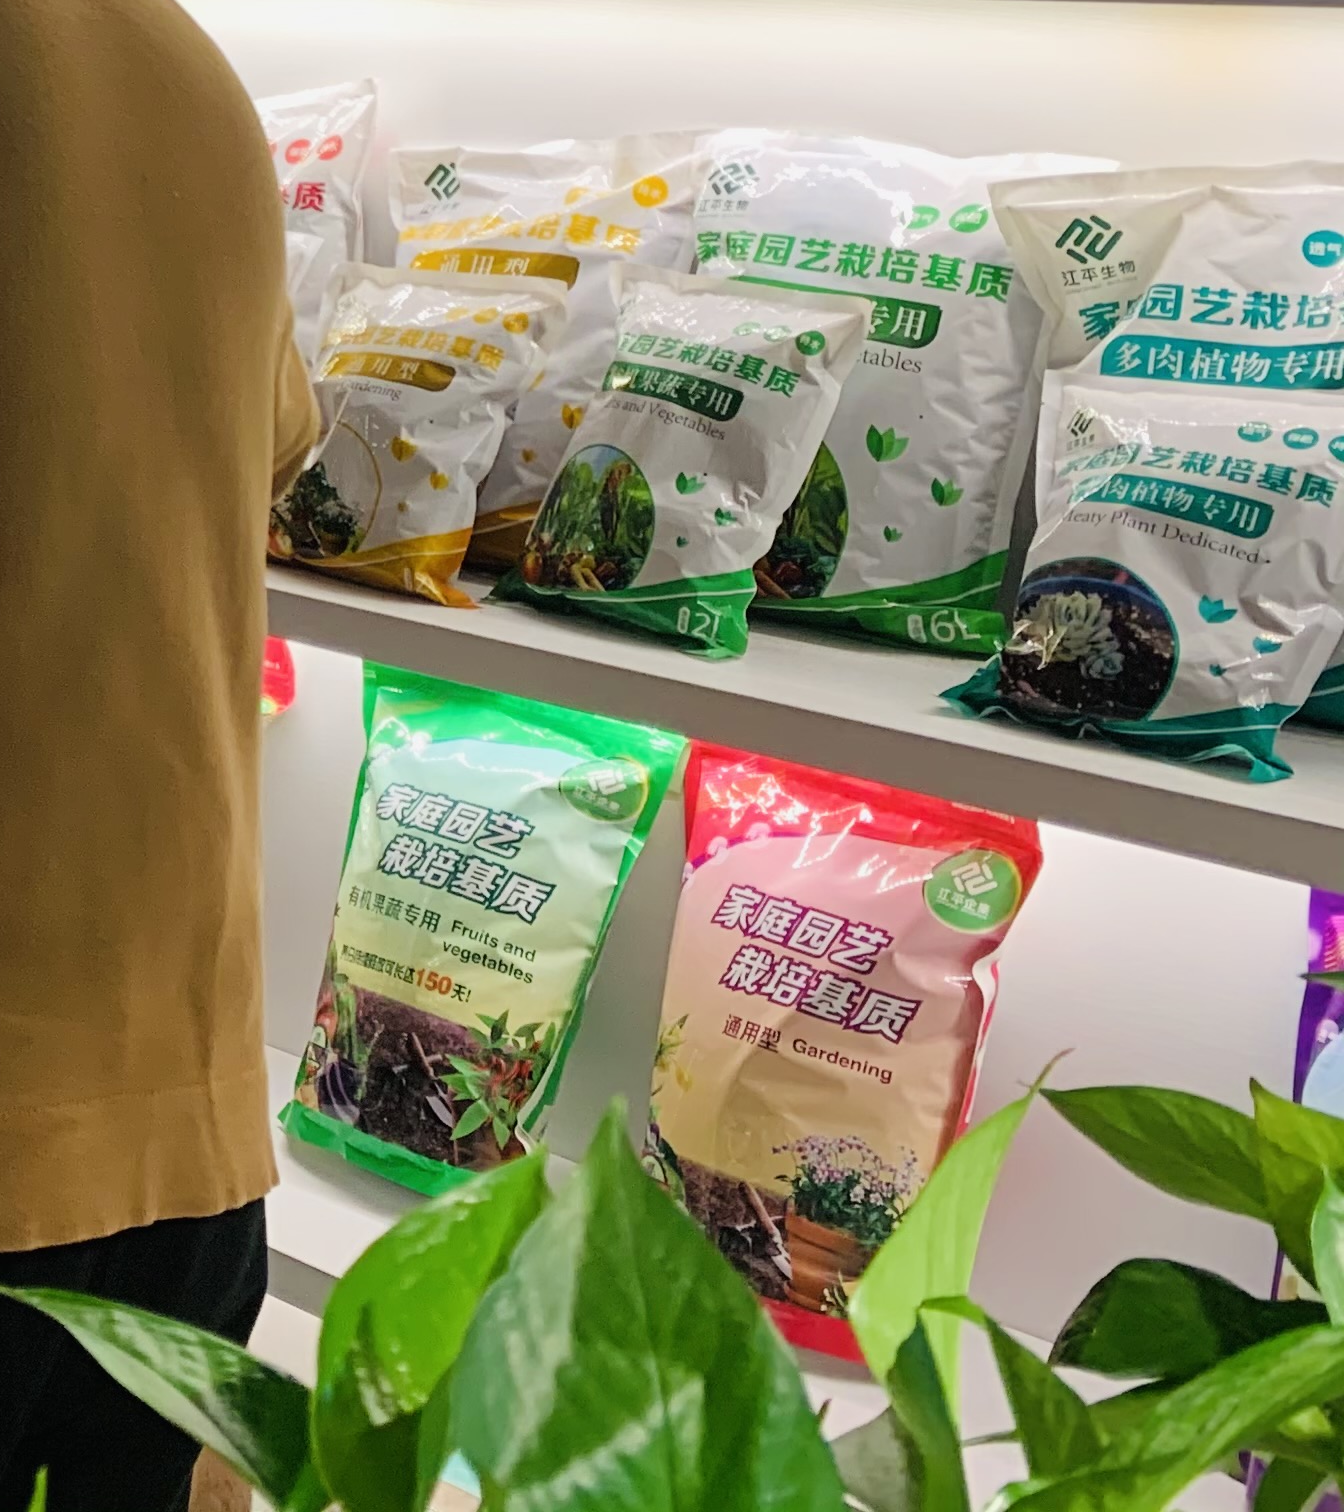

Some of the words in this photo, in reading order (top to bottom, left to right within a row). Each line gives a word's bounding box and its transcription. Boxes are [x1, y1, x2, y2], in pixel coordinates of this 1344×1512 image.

[695, 229, 1014, 304] 家庭园艺栽培基质
[1061, 259, 1136, 288] 江平生物
[1078, 283, 1344, 341] 家园艺栽培
[858, 348, 923, 375] tables
[622, 397, 646, 414] and
[647, 402, 726, 442] Vegetables
[1111, 510, 1157, 534] Plant
[1162, 523, 1260, 564] Dedicated
[375, 783, 535, 859] 家庭园艺
[378, 834, 556, 925] 栽培基质
[348, 885, 442, 933] 有机果蔬专用
[712, 883, 895, 975] 家庭园艺
[442, 940, 534, 984] vegetables
[452, 919, 499, 948] Fruits
[503, 938, 537, 963] and
[719, 944, 924, 1045] 栽培基质
[722, 1013, 782, 1054] 通用型
[792, 1038, 894, 1084] Gardening
